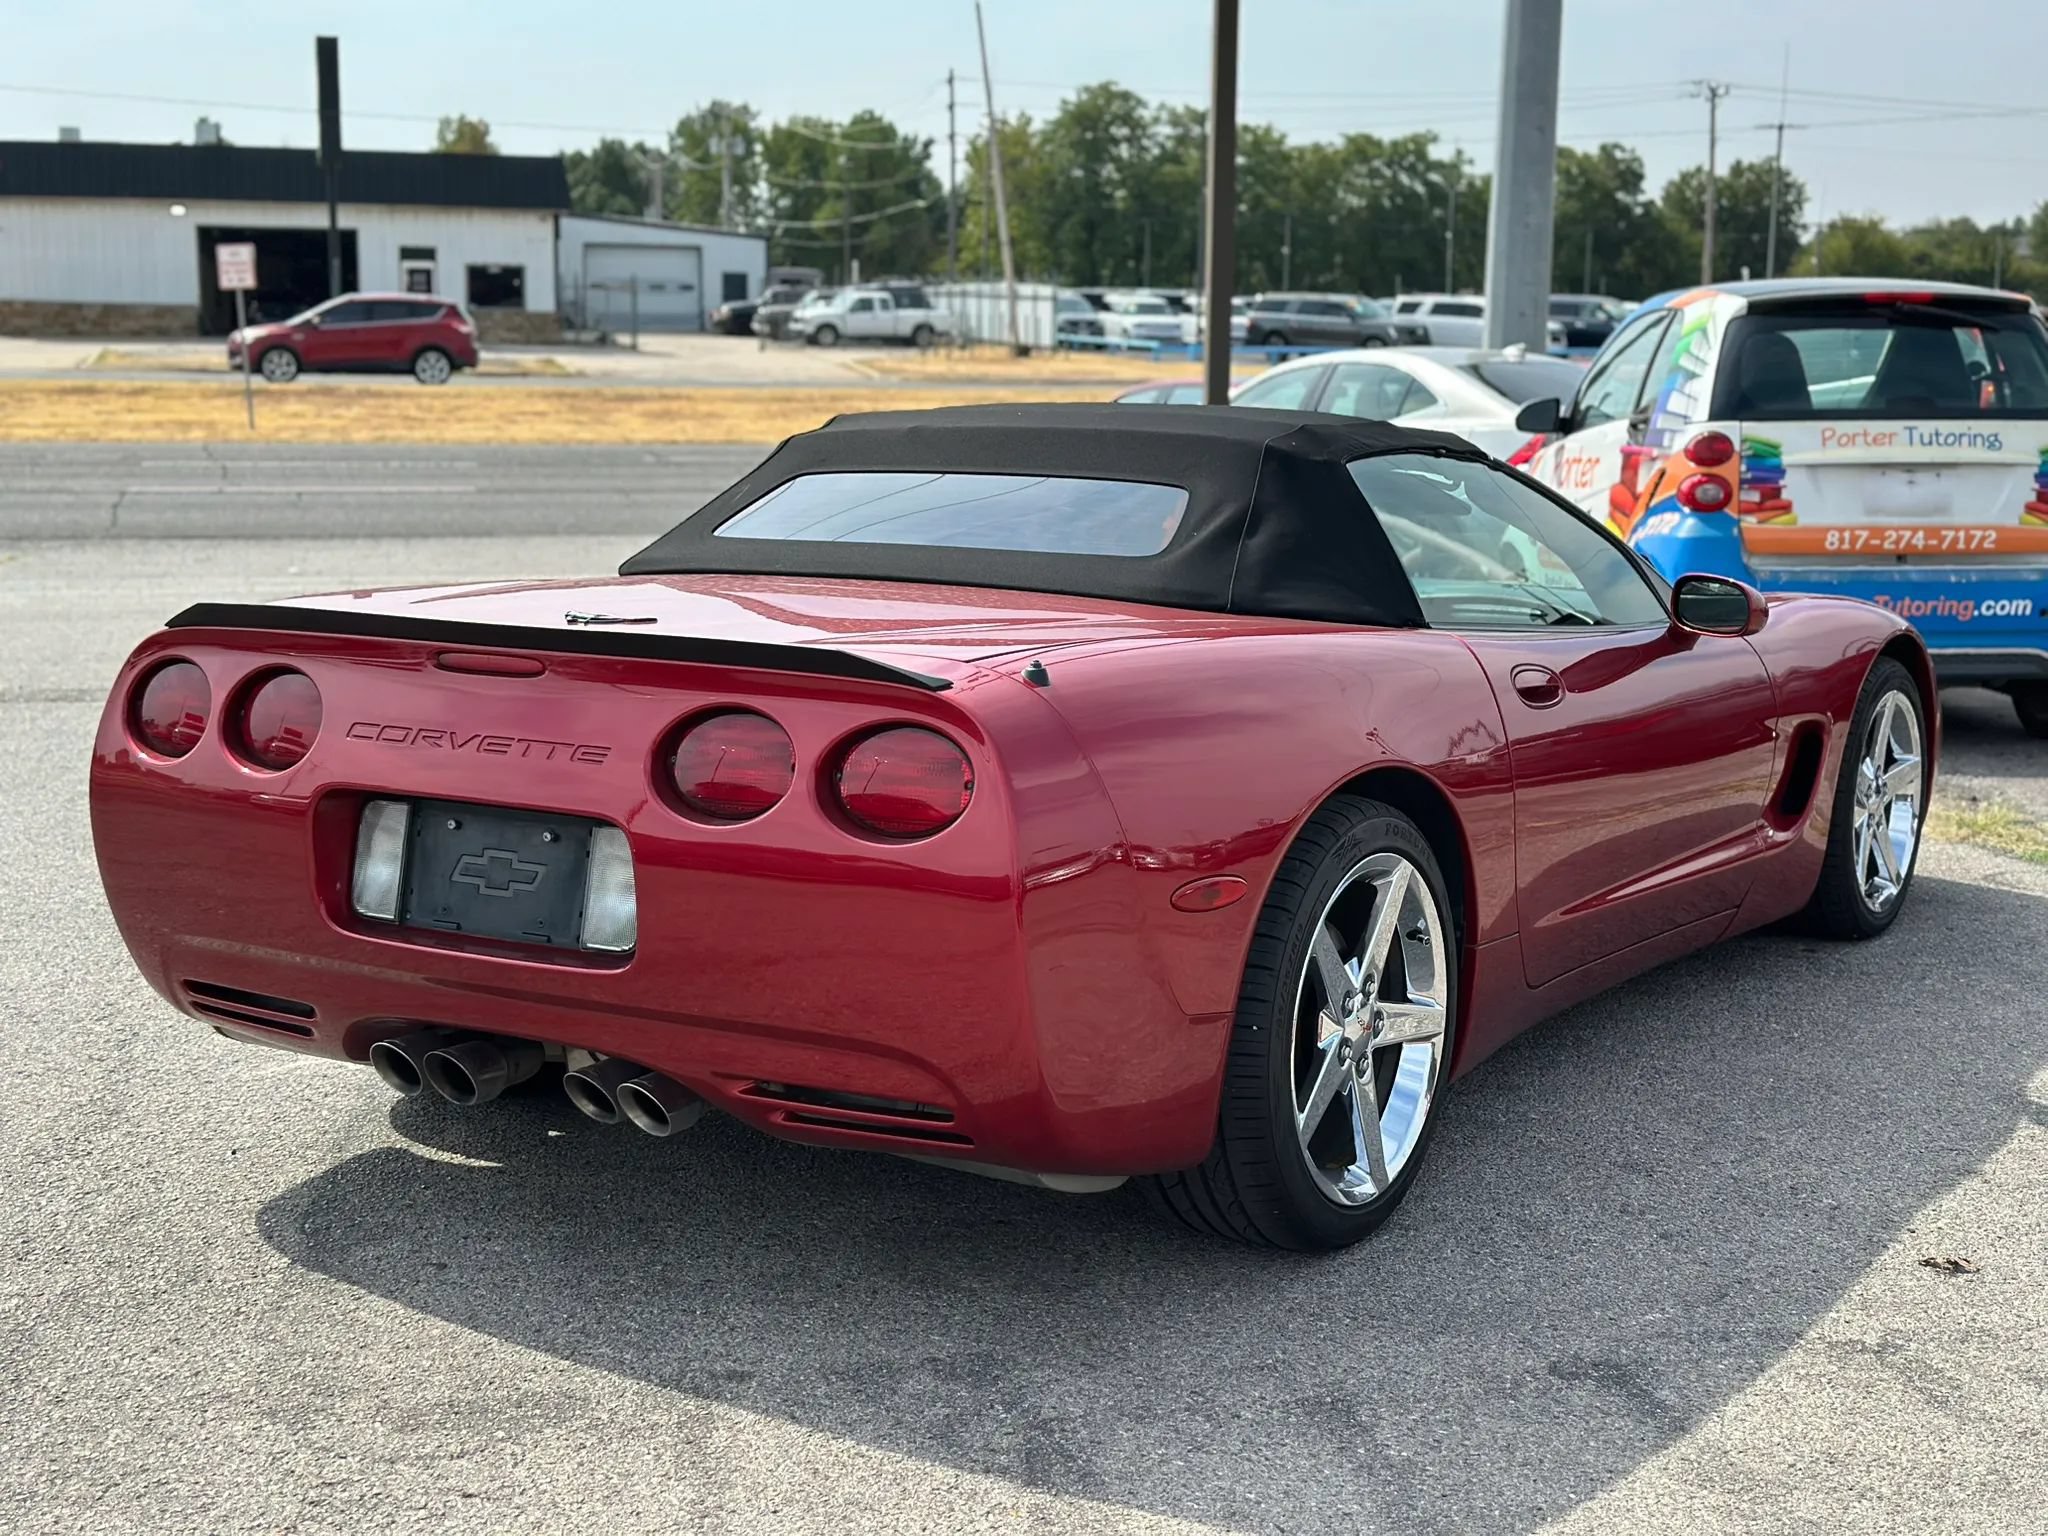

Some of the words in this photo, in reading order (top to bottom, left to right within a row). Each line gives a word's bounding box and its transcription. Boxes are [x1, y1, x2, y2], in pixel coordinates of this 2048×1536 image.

[1821, 427, 1898, 447] Porter
[1903, 425, 2003, 451] Tutoring
[1824, 529, 1997, 550] 817-274-7172
[346, 721, 612, 765] CORVETTE
